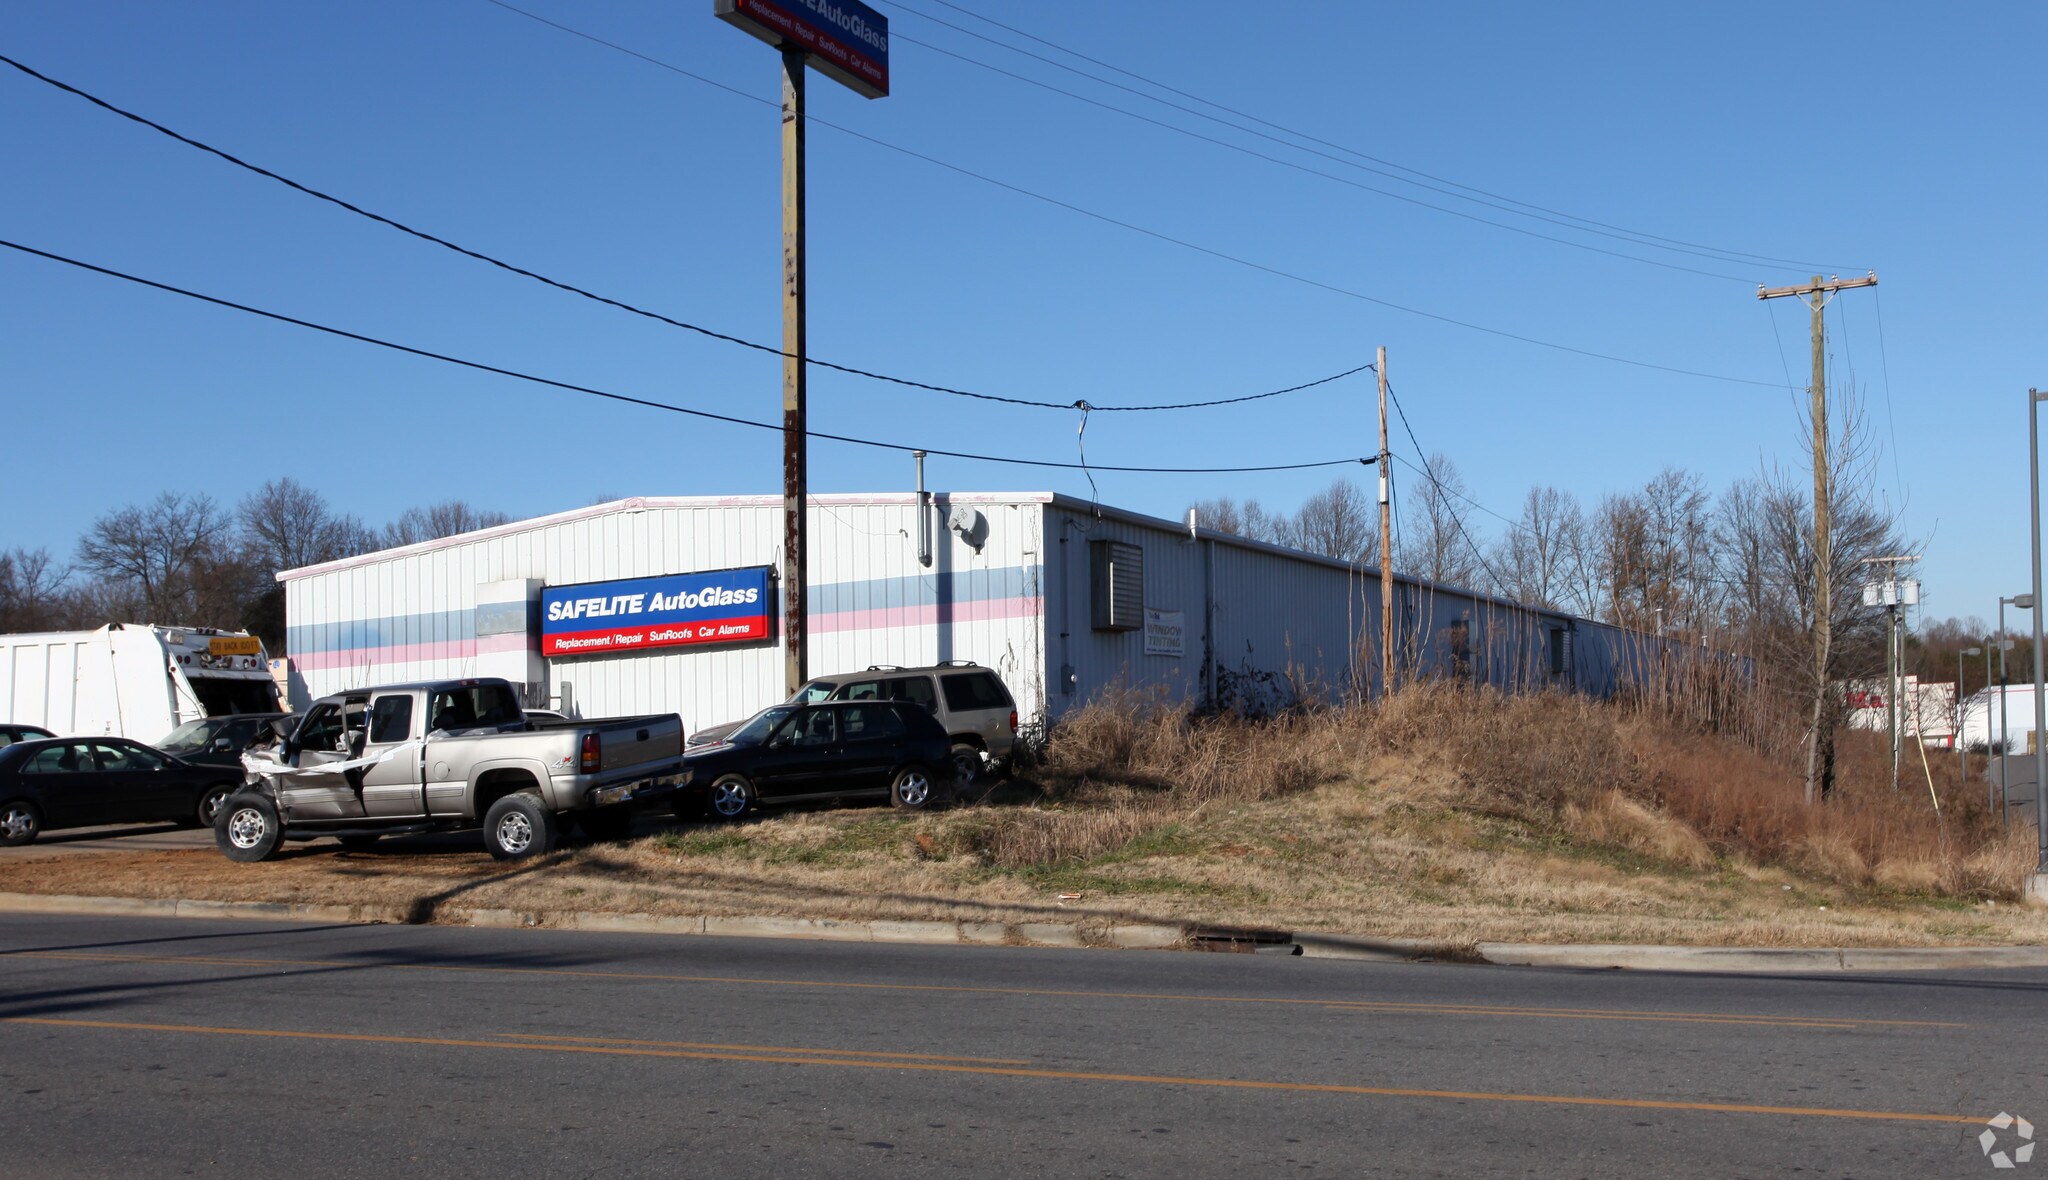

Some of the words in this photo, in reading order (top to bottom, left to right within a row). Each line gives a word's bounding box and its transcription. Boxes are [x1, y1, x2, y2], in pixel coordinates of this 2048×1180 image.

[819, 36, 848, 60] SunRoofs
[850, 54, 862, 69] Car
[862, 61, 882, 80] Alarms
[547, 593, 645, 622] SAFELITE
[648, 586, 758, 612] AutoGlass
[649, 628, 693, 642] SunRoofs
[699, 626, 715, 637] Car
[718, 624, 750, 636] Alarms
[1147, 623, 1182, 636] WINDOW
[224, 641, 238, 650] BACK
[1148, 635, 1181, 648] TINTING
